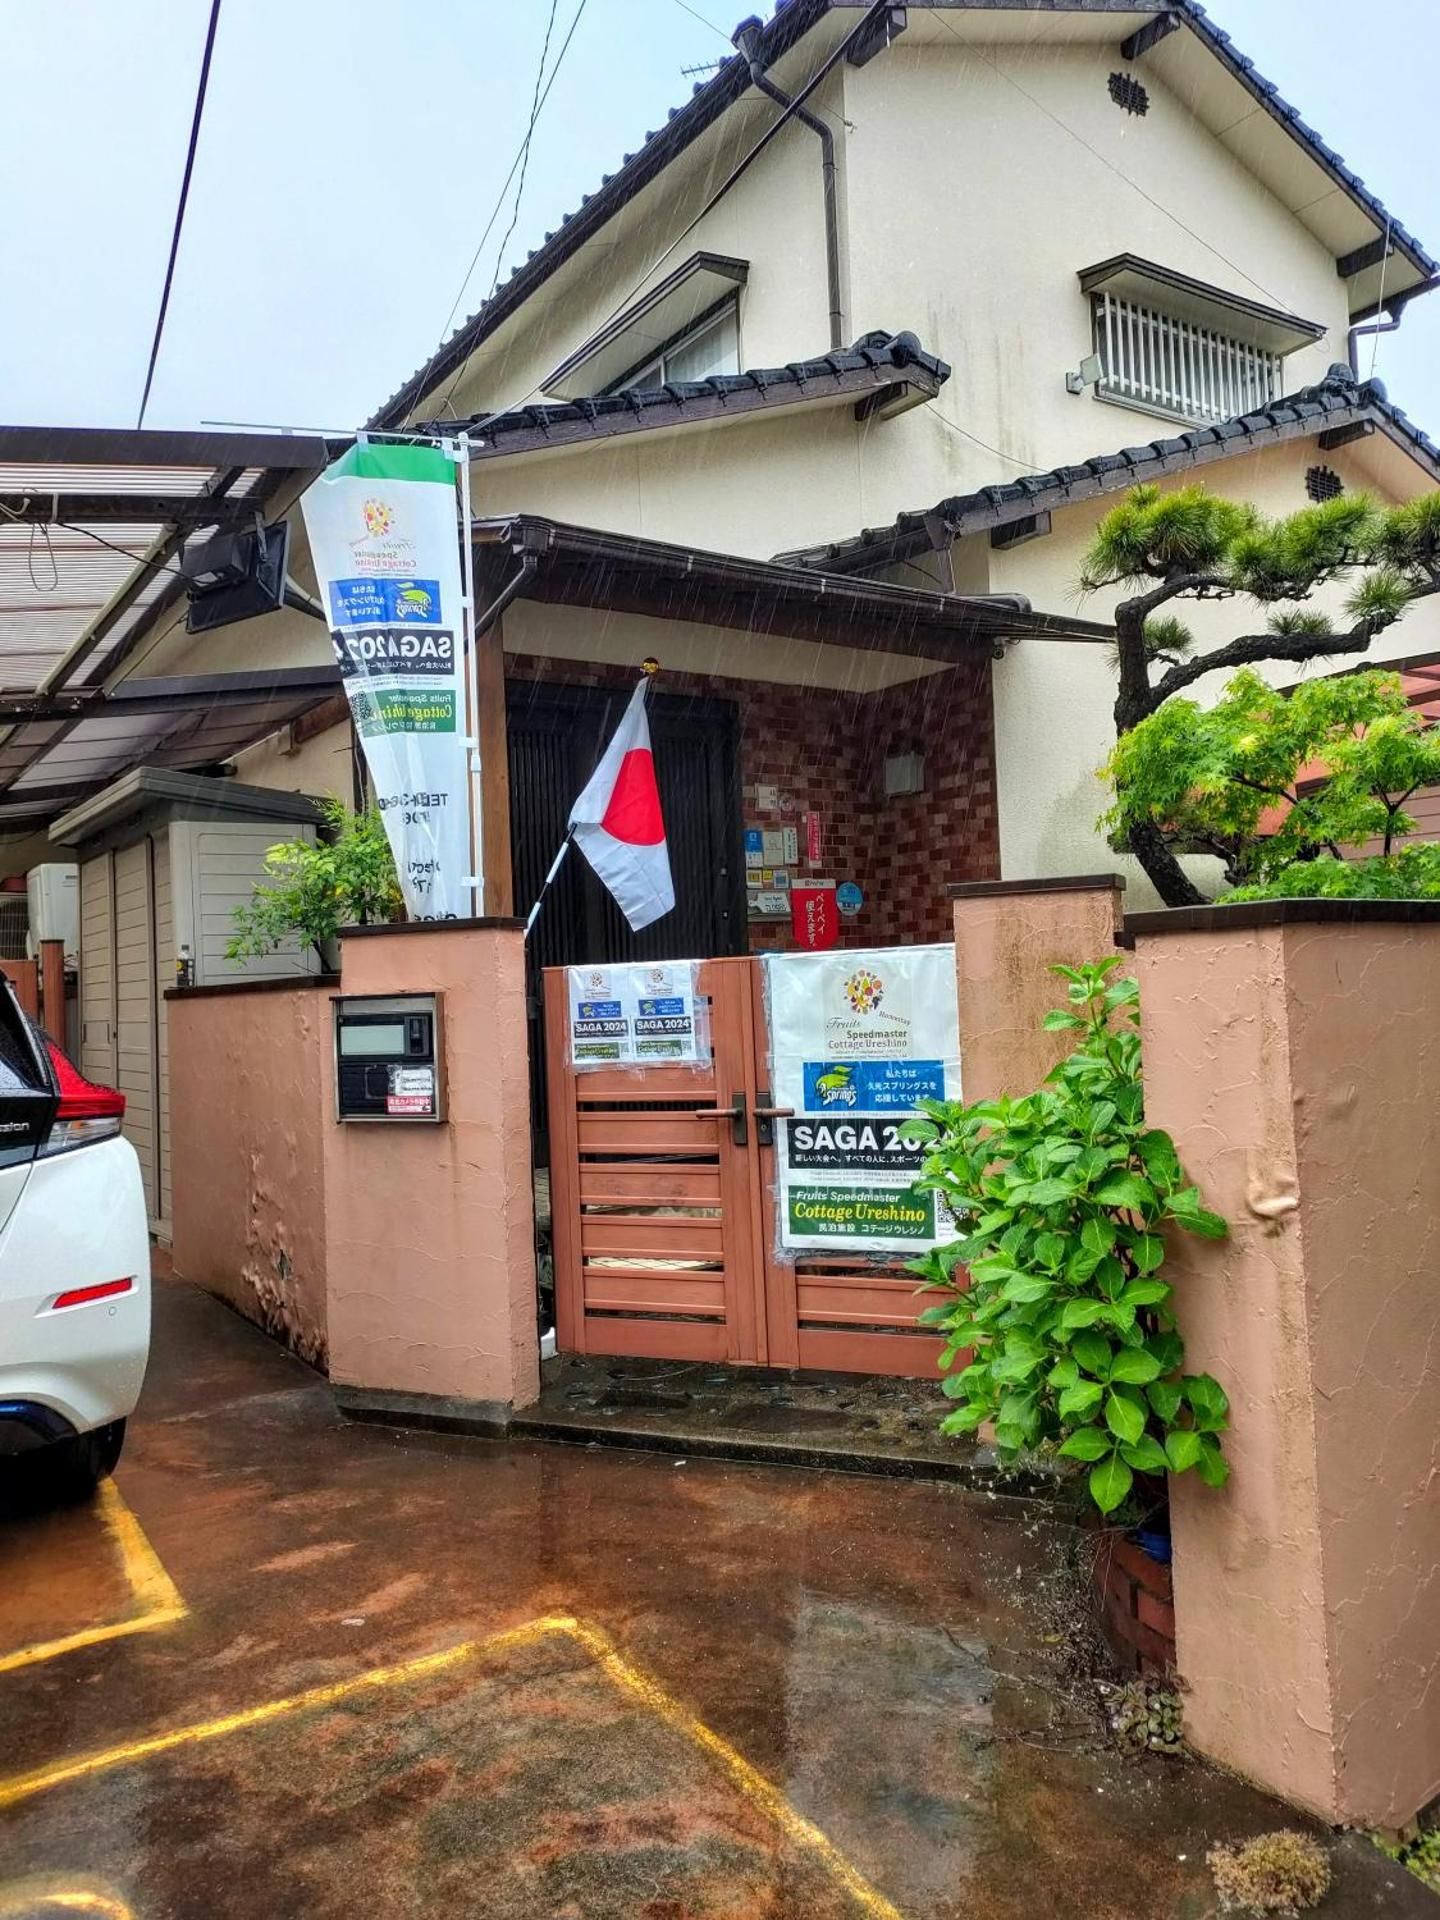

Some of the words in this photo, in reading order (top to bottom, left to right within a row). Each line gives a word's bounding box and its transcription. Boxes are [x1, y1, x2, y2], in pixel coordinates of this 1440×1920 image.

[575, 1022, 603, 1033] SAGA
[602, 1021, 627, 1032] 2024
[637, 1019, 664, 1030] SAGA
[664, 1018, 690, 1029] 2024
[847, 1029, 908, 1041] Speedmaster
[828, 1039, 864, 1050] Cottage
[865, 1038, 908, 1048] Ureshino
[794, 1126, 879, 1151] SAGA
[796, 1191, 828, 1201] Fruits
[830, 1191, 901, 1203] Speedmaster
[795, 1202, 852, 1222] Cottage
[855, 1203, 926, 1222] Ureshino
